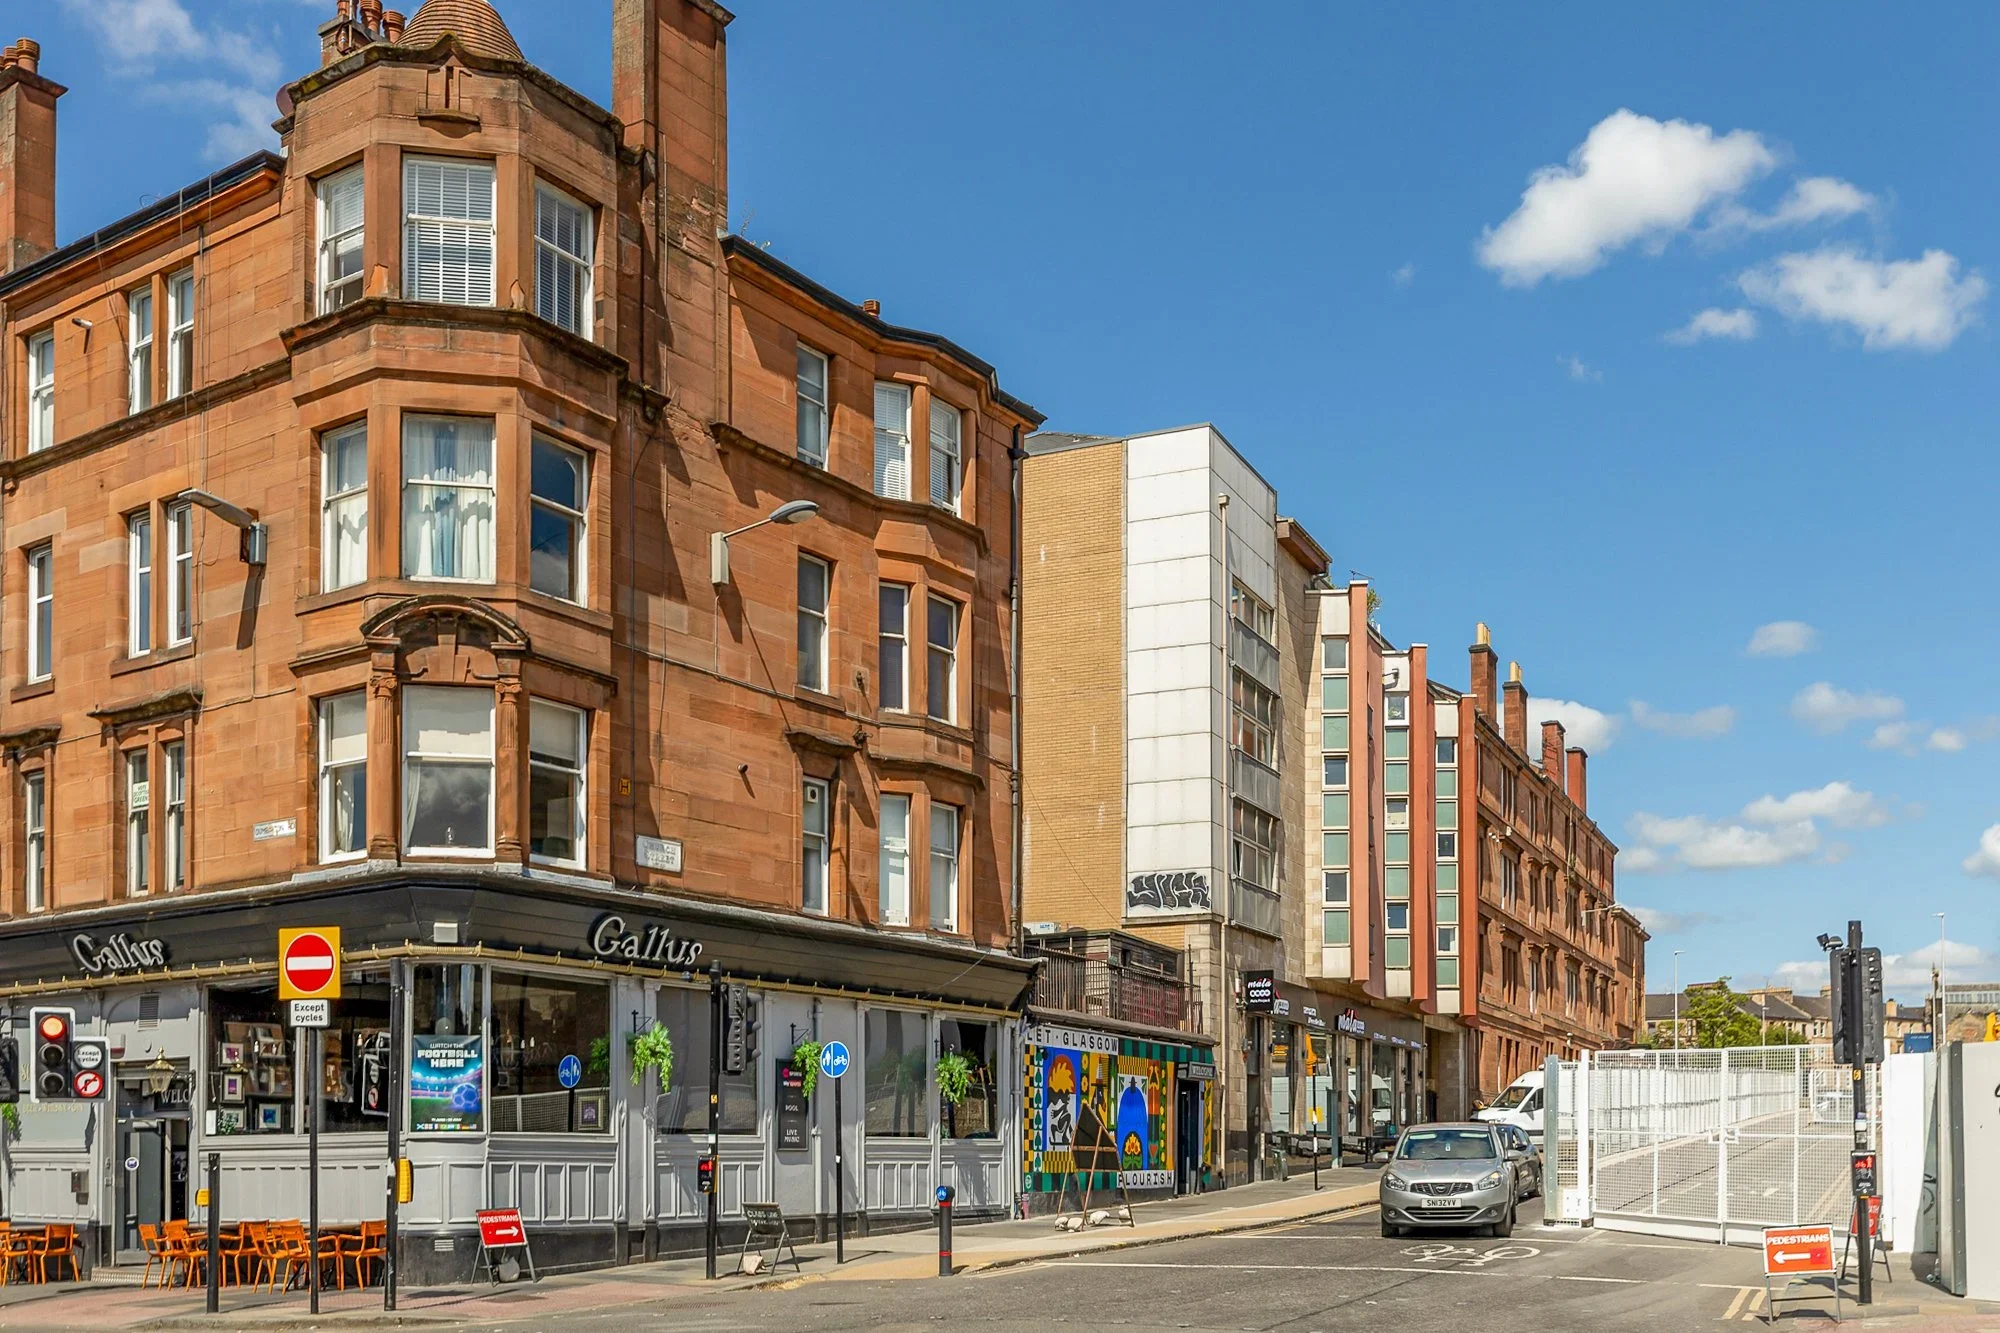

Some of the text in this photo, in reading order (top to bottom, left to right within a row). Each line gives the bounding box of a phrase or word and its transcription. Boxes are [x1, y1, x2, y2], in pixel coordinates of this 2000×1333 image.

[593, 916, 702, 965] Gallus
[73, 933, 165, 972] Gallus
[294, 1003, 325, 1012] Except
[295, 1014, 324, 1023] cycles
[1027, 1028, 1118, 1051] LET GLASGOW
[417, 1049, 478, 1059] FOOTBALL
[430, 1058, 465, 1068] HERE
[785, 1104, 799, 1112] POOL
[1118, 1172, 1172, 1187] FLOURISH
[480, 1214, 519, 1224] PEDESTRIANS
[1767, 1233, 1829, 1245] PEDESTRIANS
